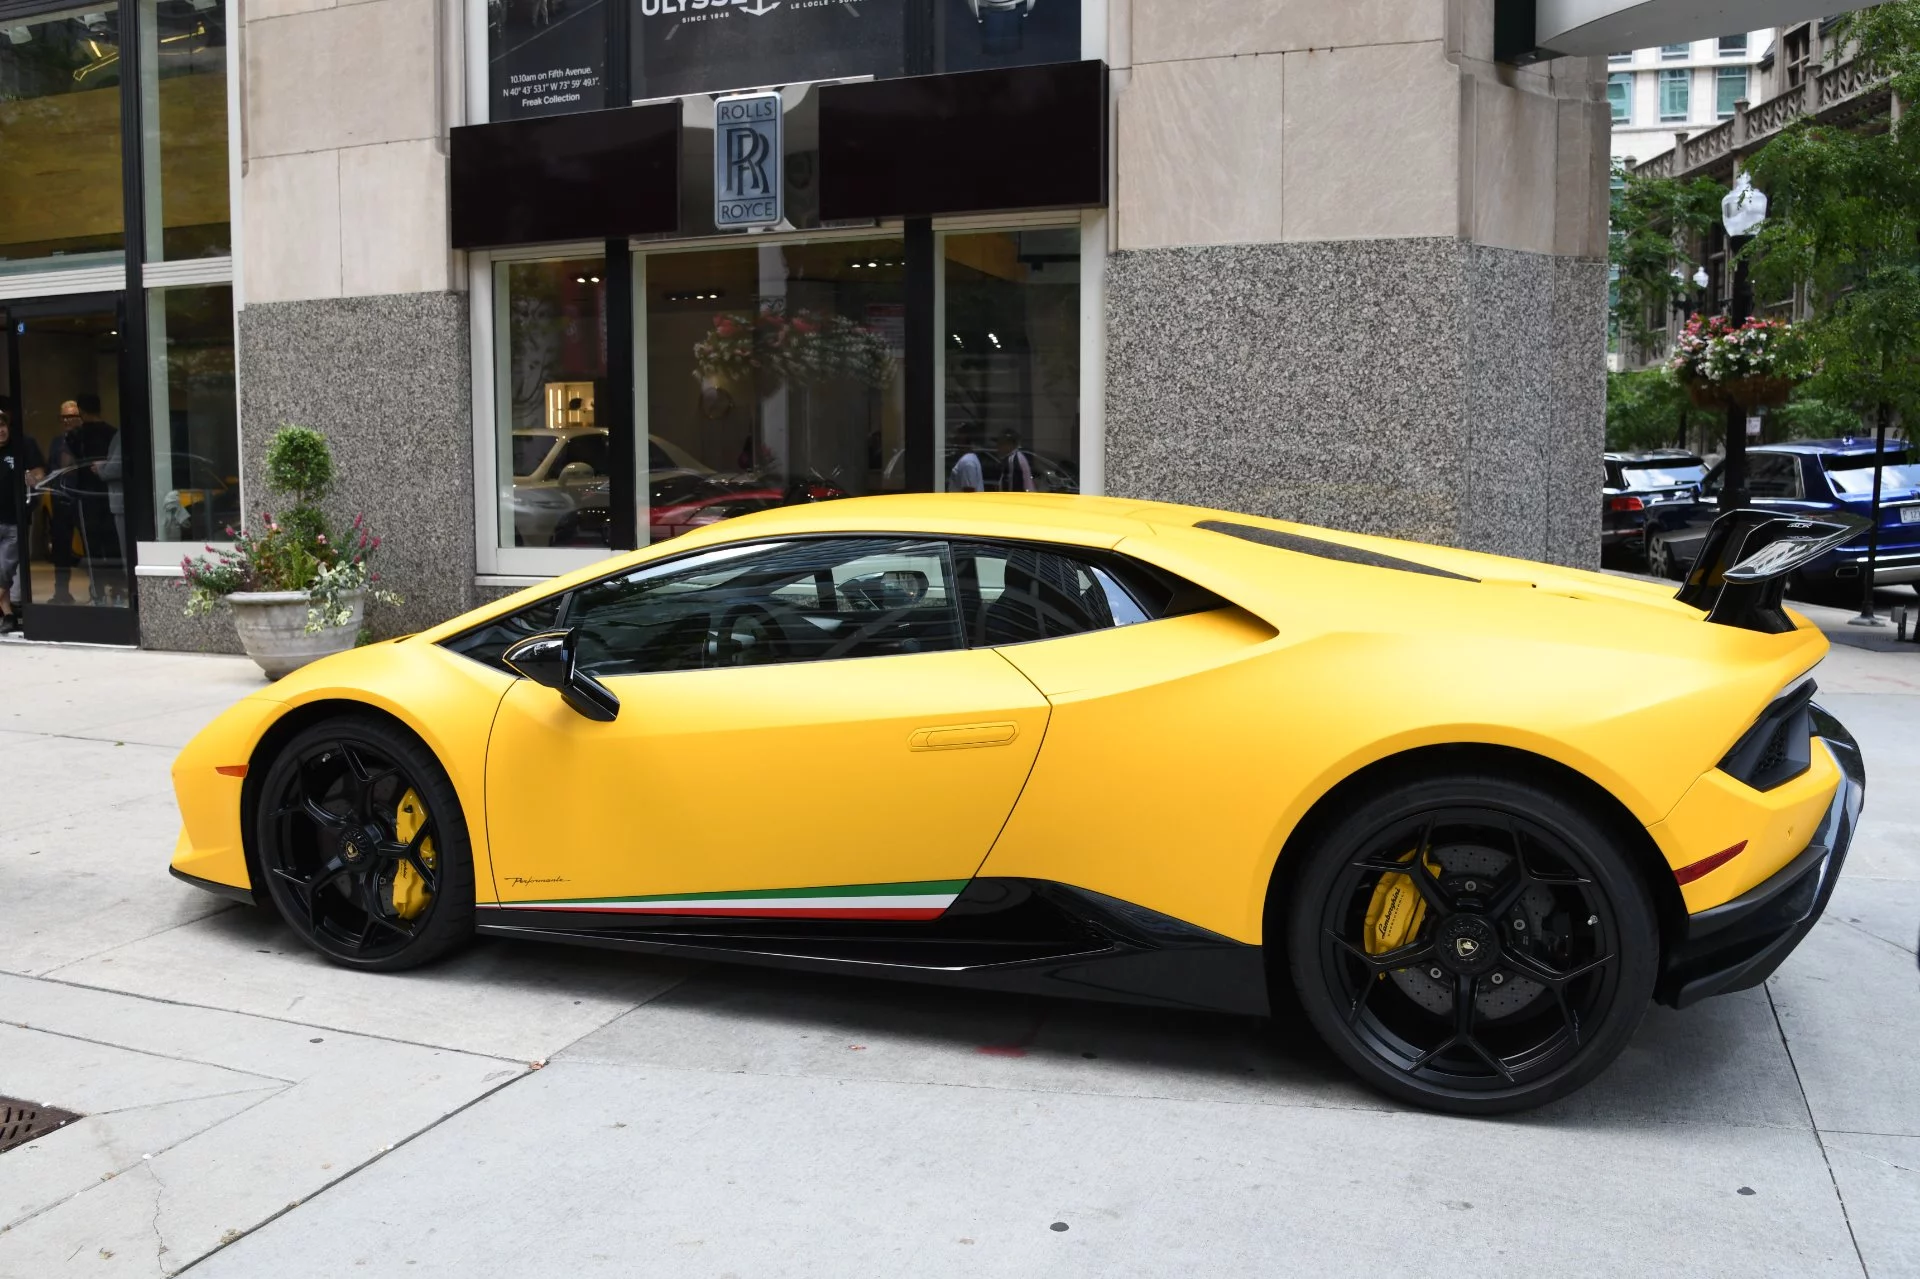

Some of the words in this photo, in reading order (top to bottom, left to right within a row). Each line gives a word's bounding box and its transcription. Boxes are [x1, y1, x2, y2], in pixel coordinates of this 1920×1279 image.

[682, 14, 706, 23] SINCE
[510, 74, 537, 84] 10.10am
[537, 73, 547, 81] on
[548, 70, 564, 79] Fifth
[565, 67, 592, 77] Avenue.
[503, 88, 509, 97] N
[550, 82, 558, 91] W
[522, 97, 542, 107] Freak
[543, 93, 580, 105] Collection
[721, 102, 772, 120] ROLLS
[721, 202, 772, 219] ROYCE
[1378, 887, 1401, 940] Lamborghini
